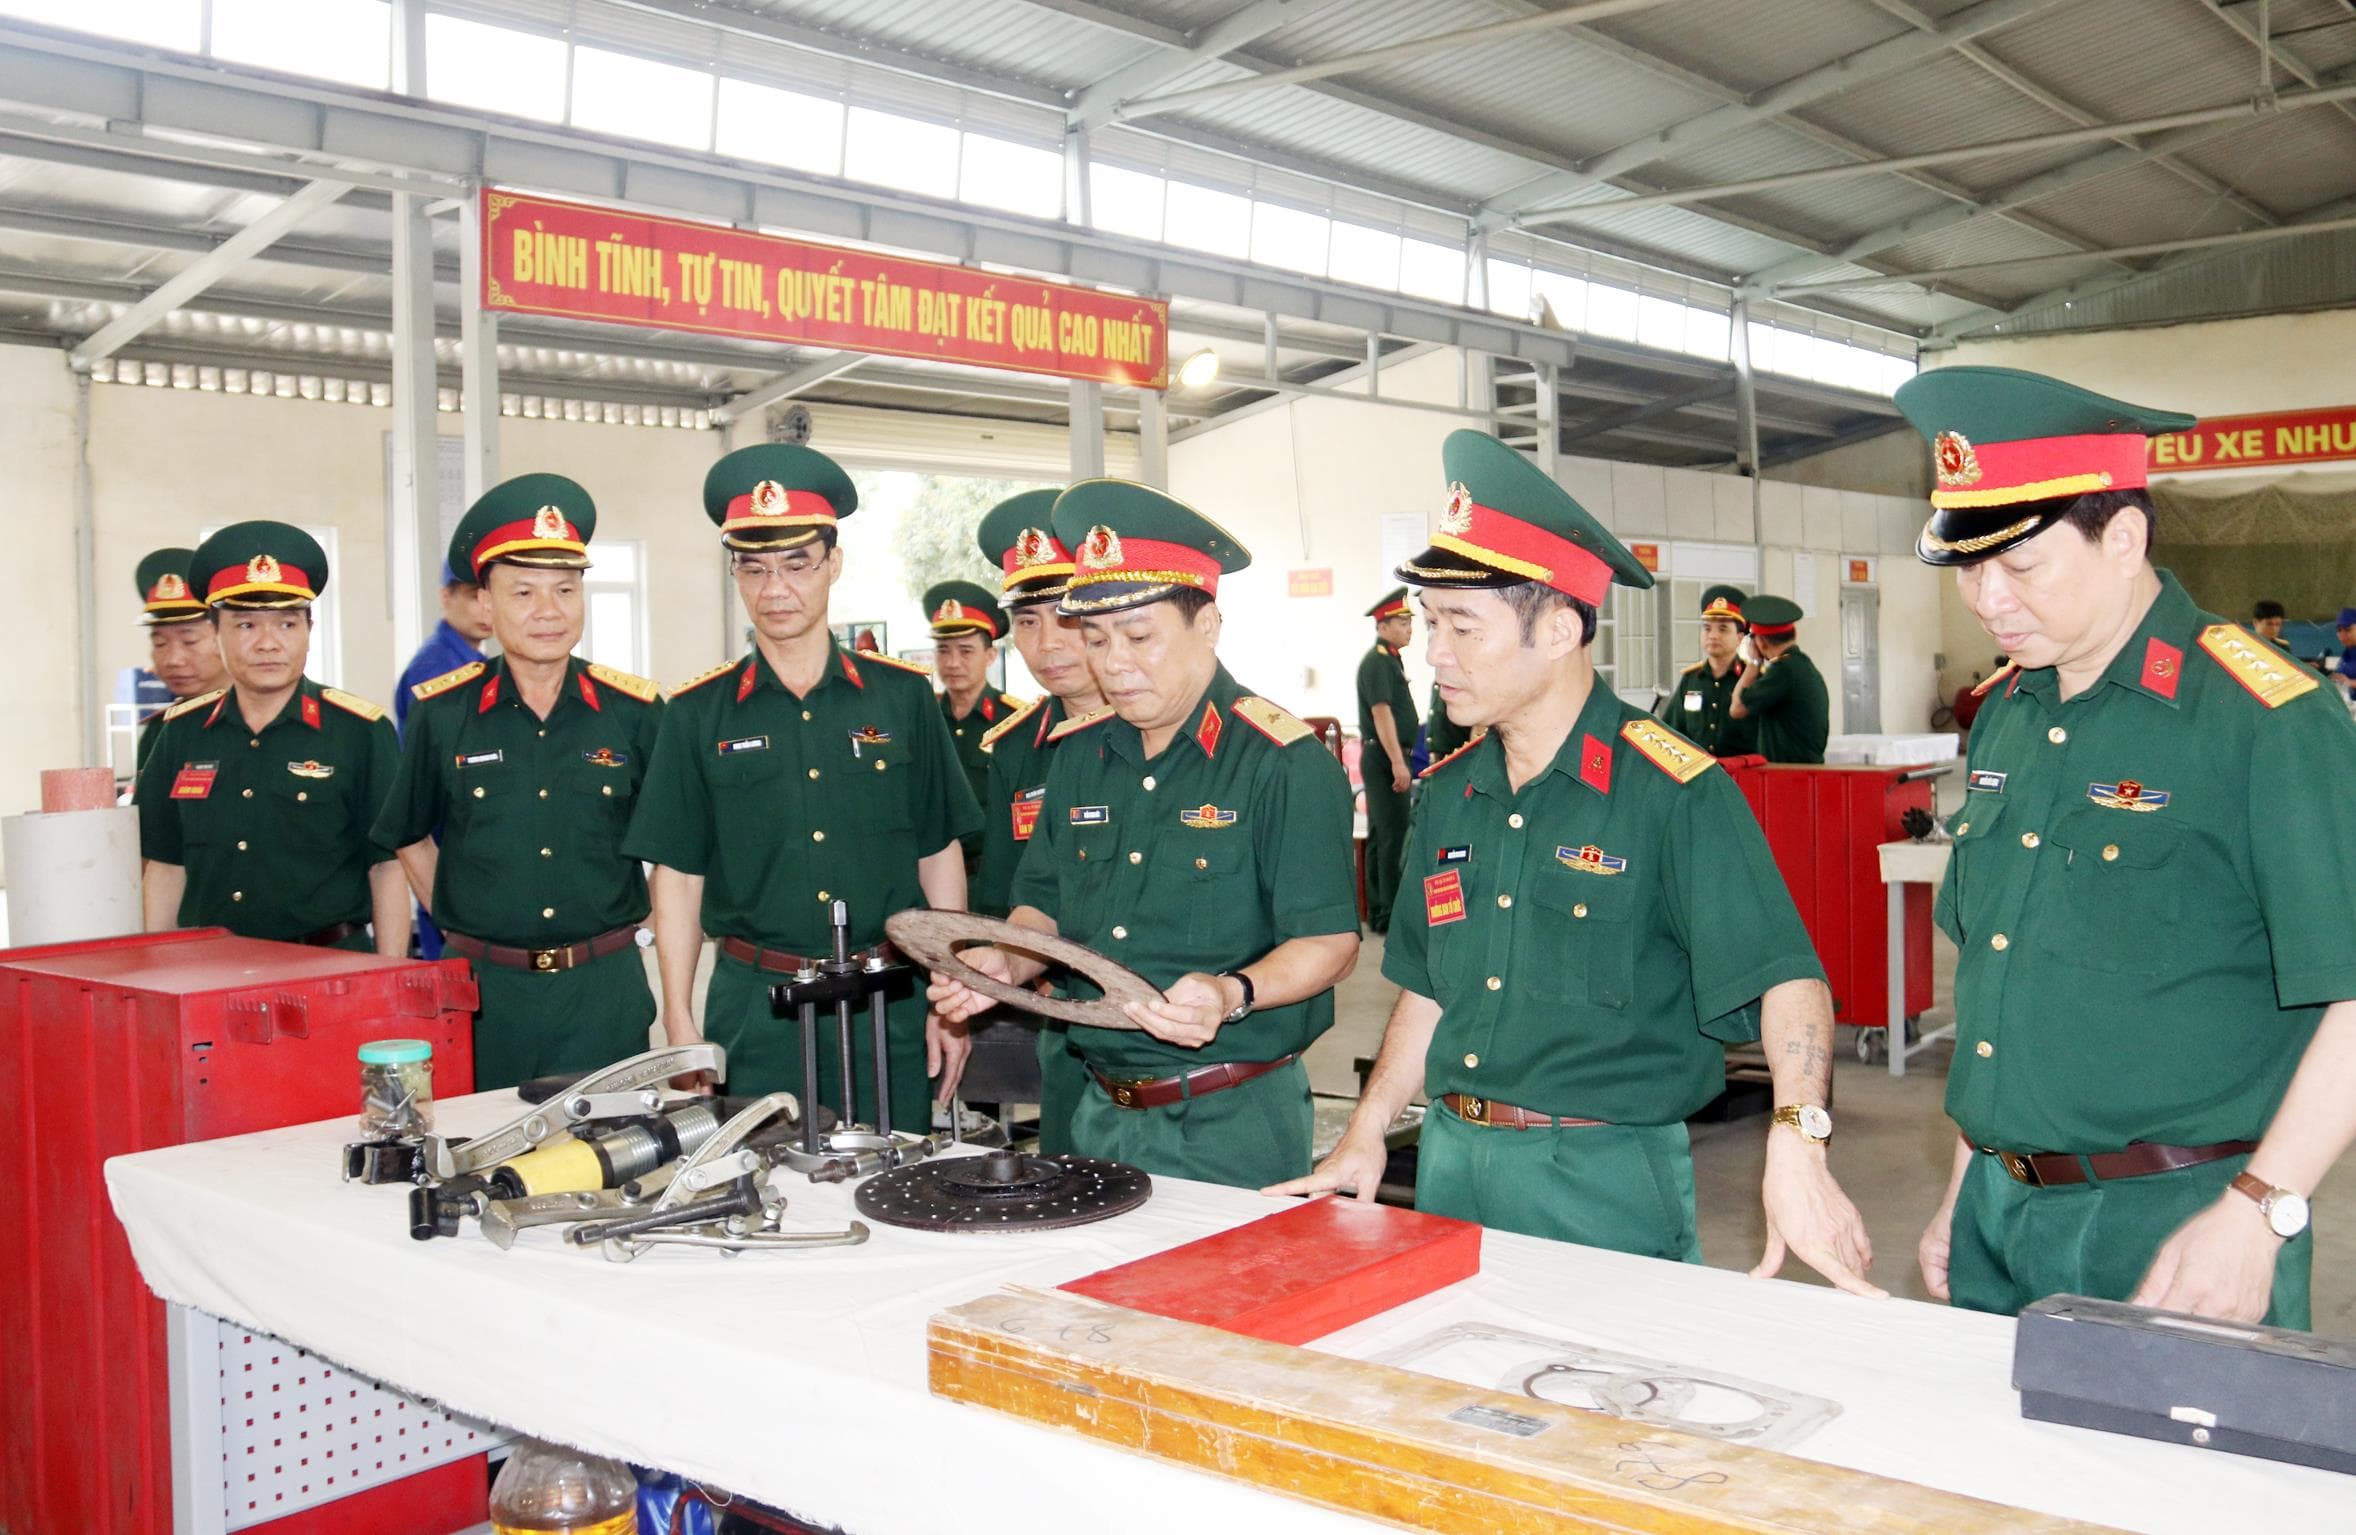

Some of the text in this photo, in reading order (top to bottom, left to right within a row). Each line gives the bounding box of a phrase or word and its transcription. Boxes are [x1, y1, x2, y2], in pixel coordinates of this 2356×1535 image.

[513, 219, 1153, 366] BÌNH TĨNH, TỰ TIN, QUYẾT TÂM ĐẠT KẾT QUẢ CAO NHẤT
[2213, 428, 2264, 460] XE
